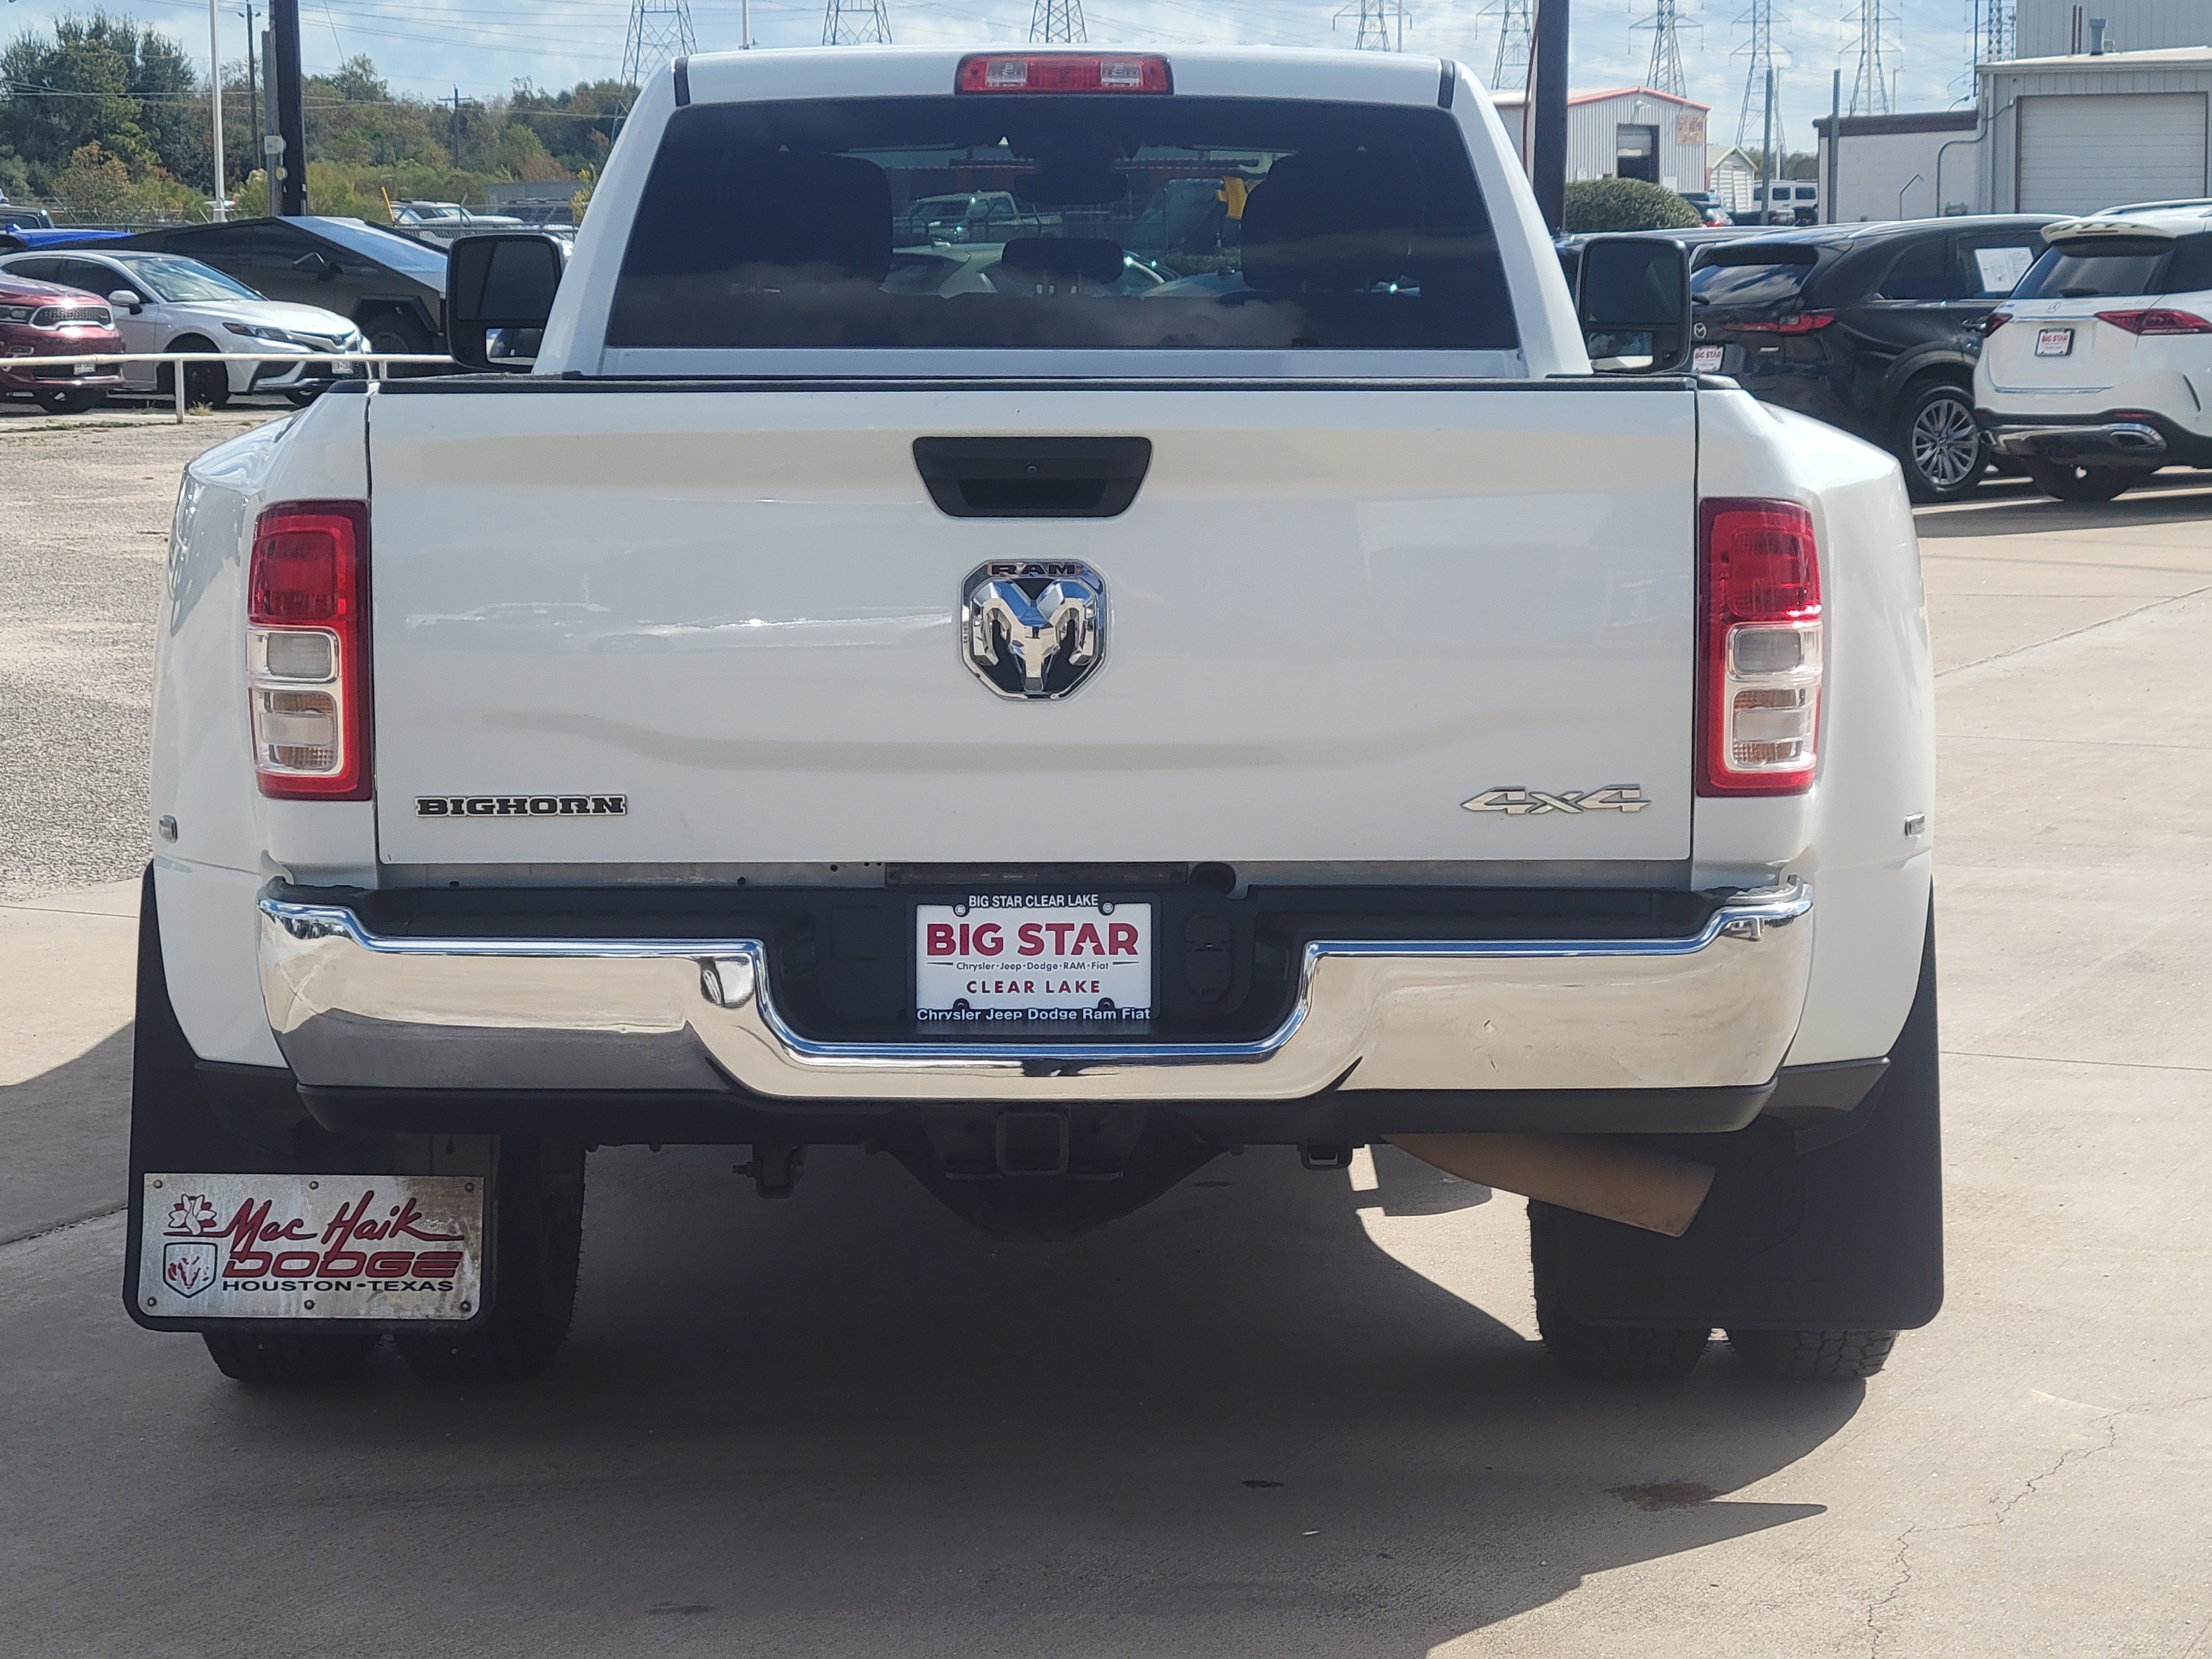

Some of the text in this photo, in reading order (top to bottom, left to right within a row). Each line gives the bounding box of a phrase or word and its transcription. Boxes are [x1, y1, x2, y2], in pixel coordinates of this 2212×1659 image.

[991, 564, 1075, 575] RAM
[1460, 783, 1651, 814] 4x4
[415, 795, 627, 817] BIGHORN
[968, 894, 1099, 907] BIG STAR CLEAR LAKE
[927, 923, 1139, 956] BIG STAR
[956, 961, 1109, 972] Chrysler Jeep Dodge RAM Fiat
[966, 980, 1100, 994] CLEAR LAKE
[917, 1008, 1151, 1020] Chrysler Jeep Dodge Ram Fiat
[221, 1189, 464, 1262] Mac Haik
[222, 1251, 463, 1278] DODGE
[222, 1280, 454, 1292] HOUSTON TEXAS
